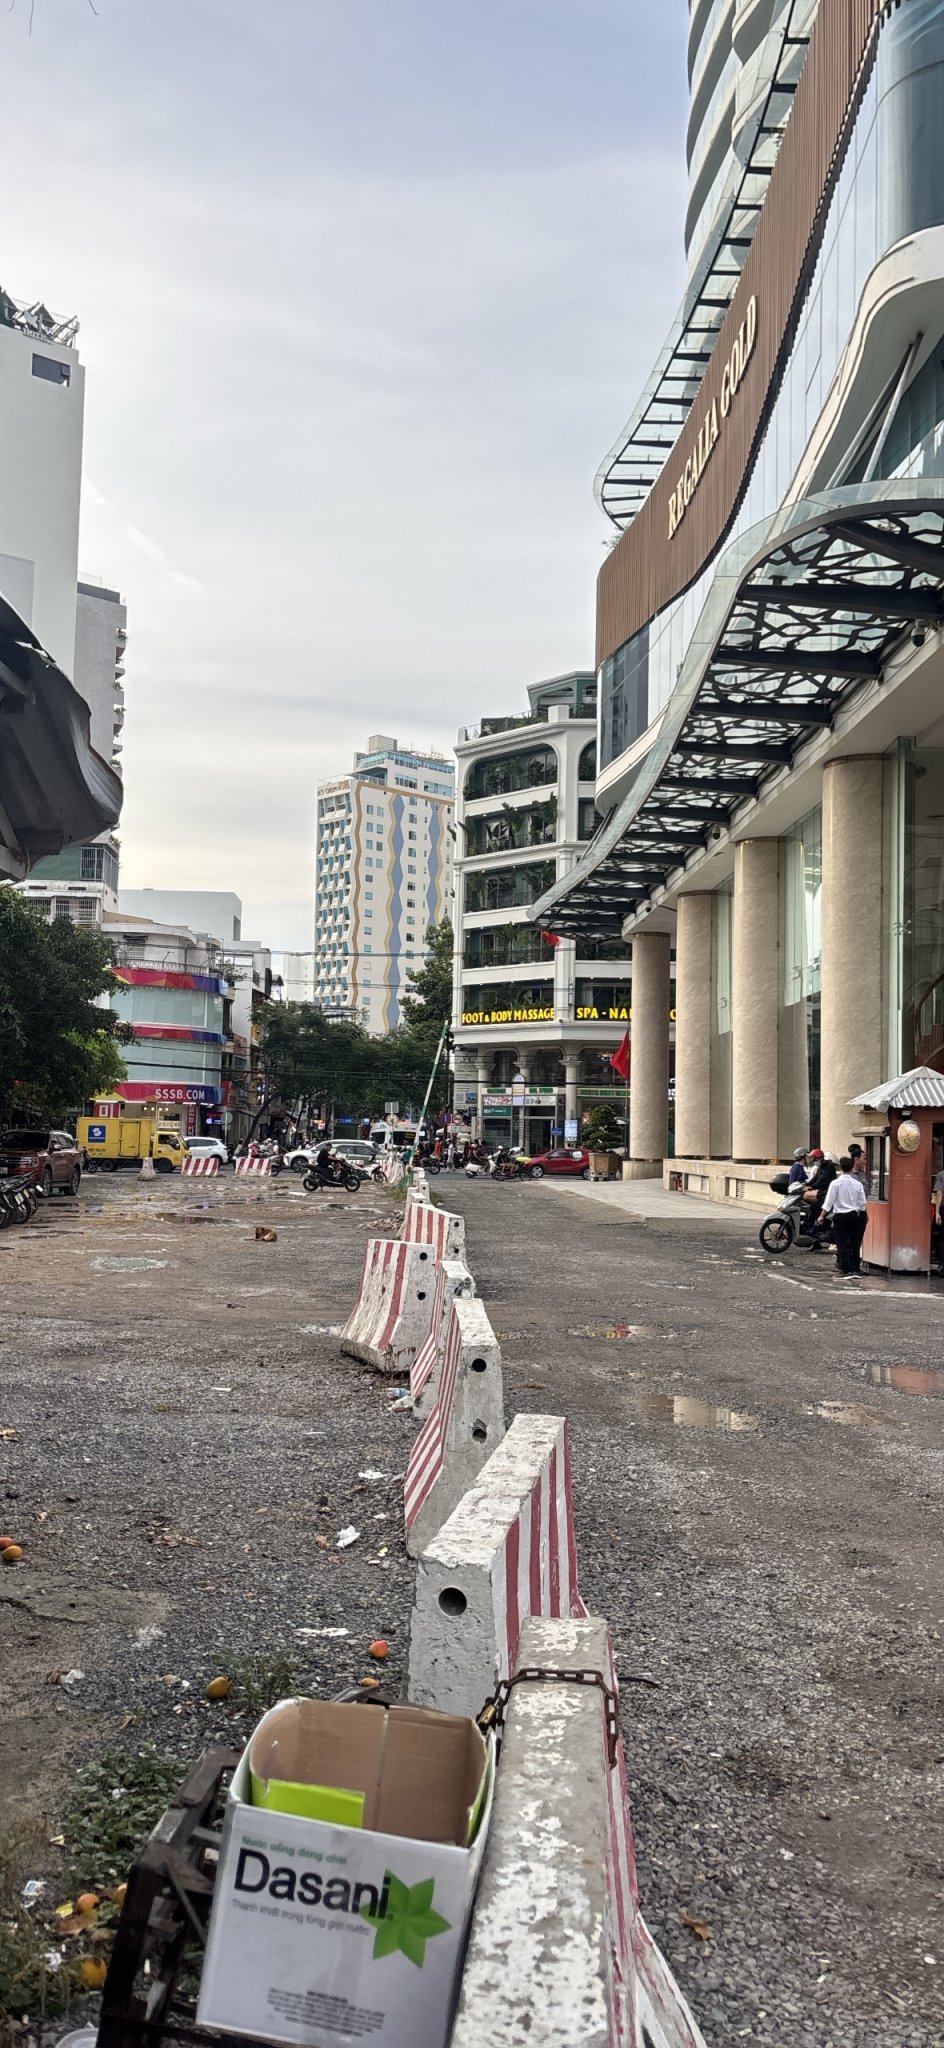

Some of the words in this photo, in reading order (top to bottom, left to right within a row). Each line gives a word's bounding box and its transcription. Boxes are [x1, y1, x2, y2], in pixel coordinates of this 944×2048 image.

[668, 397, 719, 540] REGALIA
[721, 295, 757, 418] GOLD
[462, 1012, 484, 1024] FOOT
[484, 1014, 490, 1023] &
[491, 1010, 513, 1022] BODY
[513, 1007, 555, 1021] MASSAGE
[576, 1007, 599, 1019] SPA
[609, 1007, 632, 1019] NAI
[154, 1088, 205, 1100] SSSB.COM
[234, 1847, 391, 1920] Dasani
